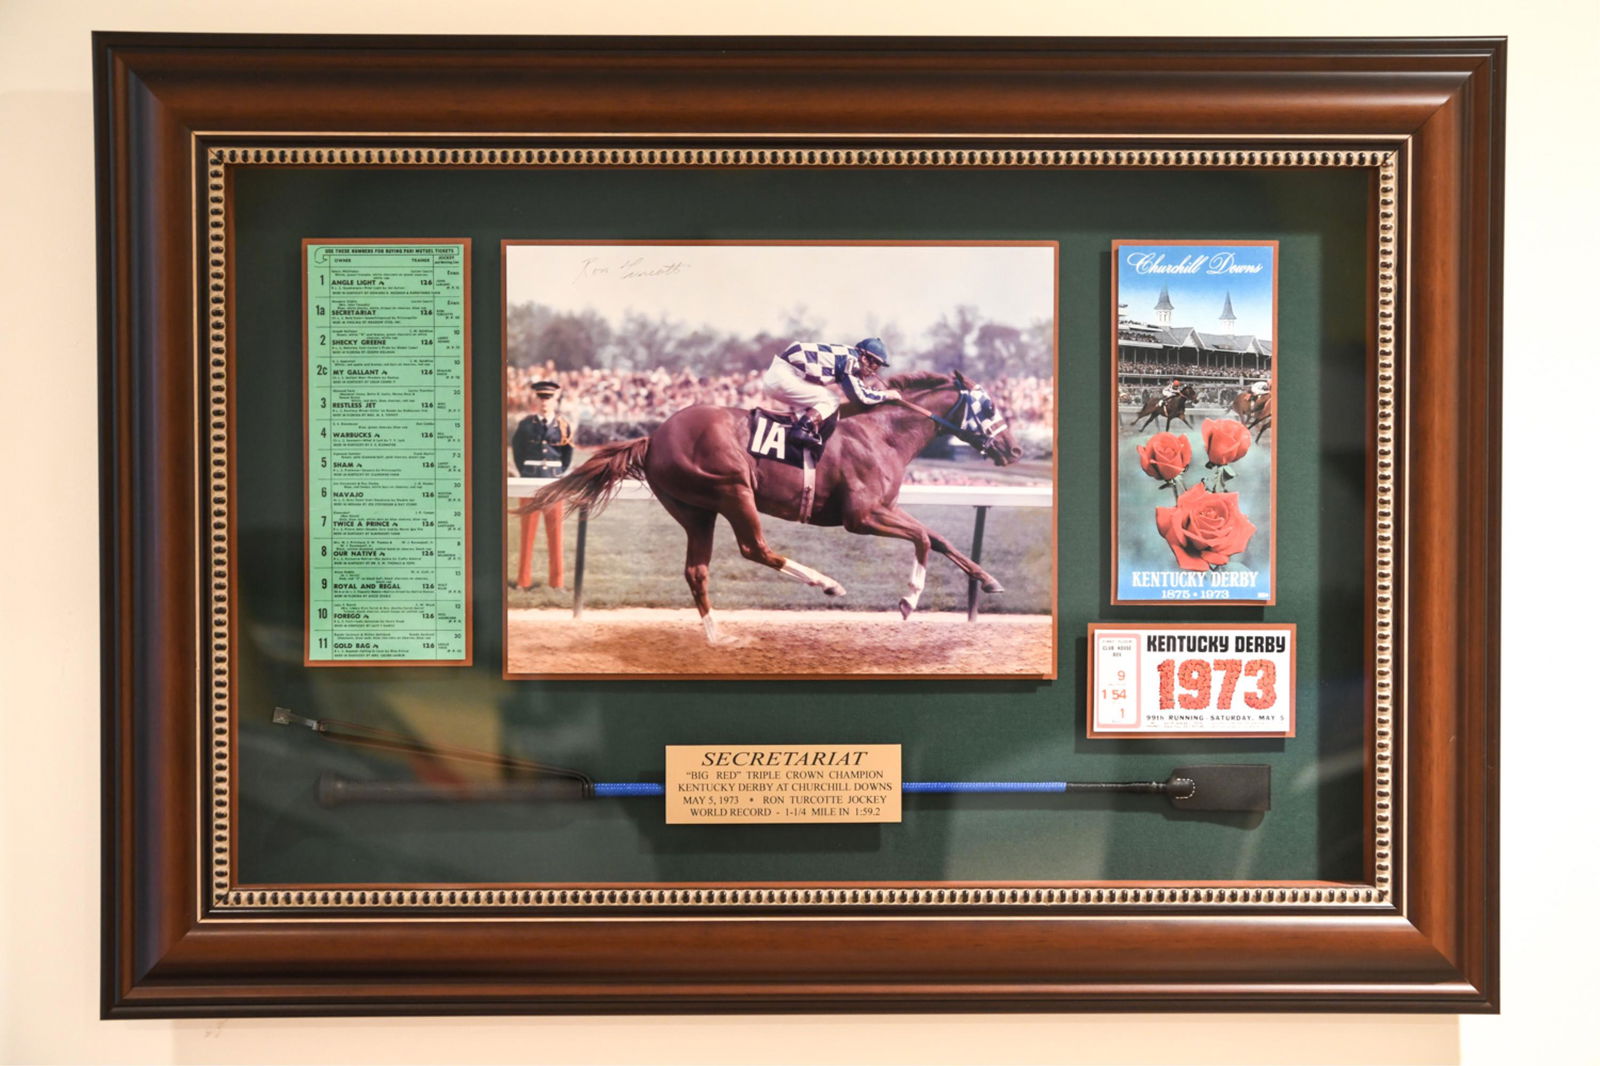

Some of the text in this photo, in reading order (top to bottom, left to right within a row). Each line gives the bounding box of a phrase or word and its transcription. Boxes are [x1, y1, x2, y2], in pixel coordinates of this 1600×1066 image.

[1127, 252, 1263, 274] Churchill Downs
[320, 275, 324, 285] 1
[316, 305, 325, 315] 1a
[320, 335, 326, 345] 2
[317, 365, 327, 375] 2c
[321, 397, 326, 408] 3
[321, 428, 326, 438] 4
[321, 457, 327, 468] 5
[322, 487, 327, 497] 6
[321, 516, 326, 527] 7
[322, 546, 327, 556] 8
[322, 579, 327, 589] 9
[1132, 571, 1258, 587] KENTUCKY DERBY
[1162, 590, 1230, 599] 1875 1973
[318, 608, 327, 619] 10
[319, 638, 327, 648] 11
[1146, 635, 1286, 653] KENTUCKY DERBY
[1118, 670, 1126, 681] 9
[1157, 659, 1276, 710] 1973
[1102, 688, 1127, 700] 1 54
[1120, 708, 1125, 719] 1
[702, 752, 867, 766] SECRETARIAT
[786, 771, 823, 779] CROWN
[829, 771, 883, 779] CHAMPION
[678, 783, 735, 792] KENTUCKY
[776, 783, 788, 791] AT
[792, 783, 850, 791] CHURCHILL
[854, 783, 892, 791] DOWNS
[683, 796, 887, 805] MAY 5, 1973 RON TURCOTTE JOCKEY
[690, 808, 727, 816] WORLD
[730, 808, 771, 816] RECORD
[785, 808, 806, 816] 1-1/4
[812, 808, 836, 816] MILE
[839, 808, 849, 816] IN
[855, 808, 880, 816] 1:59.2
